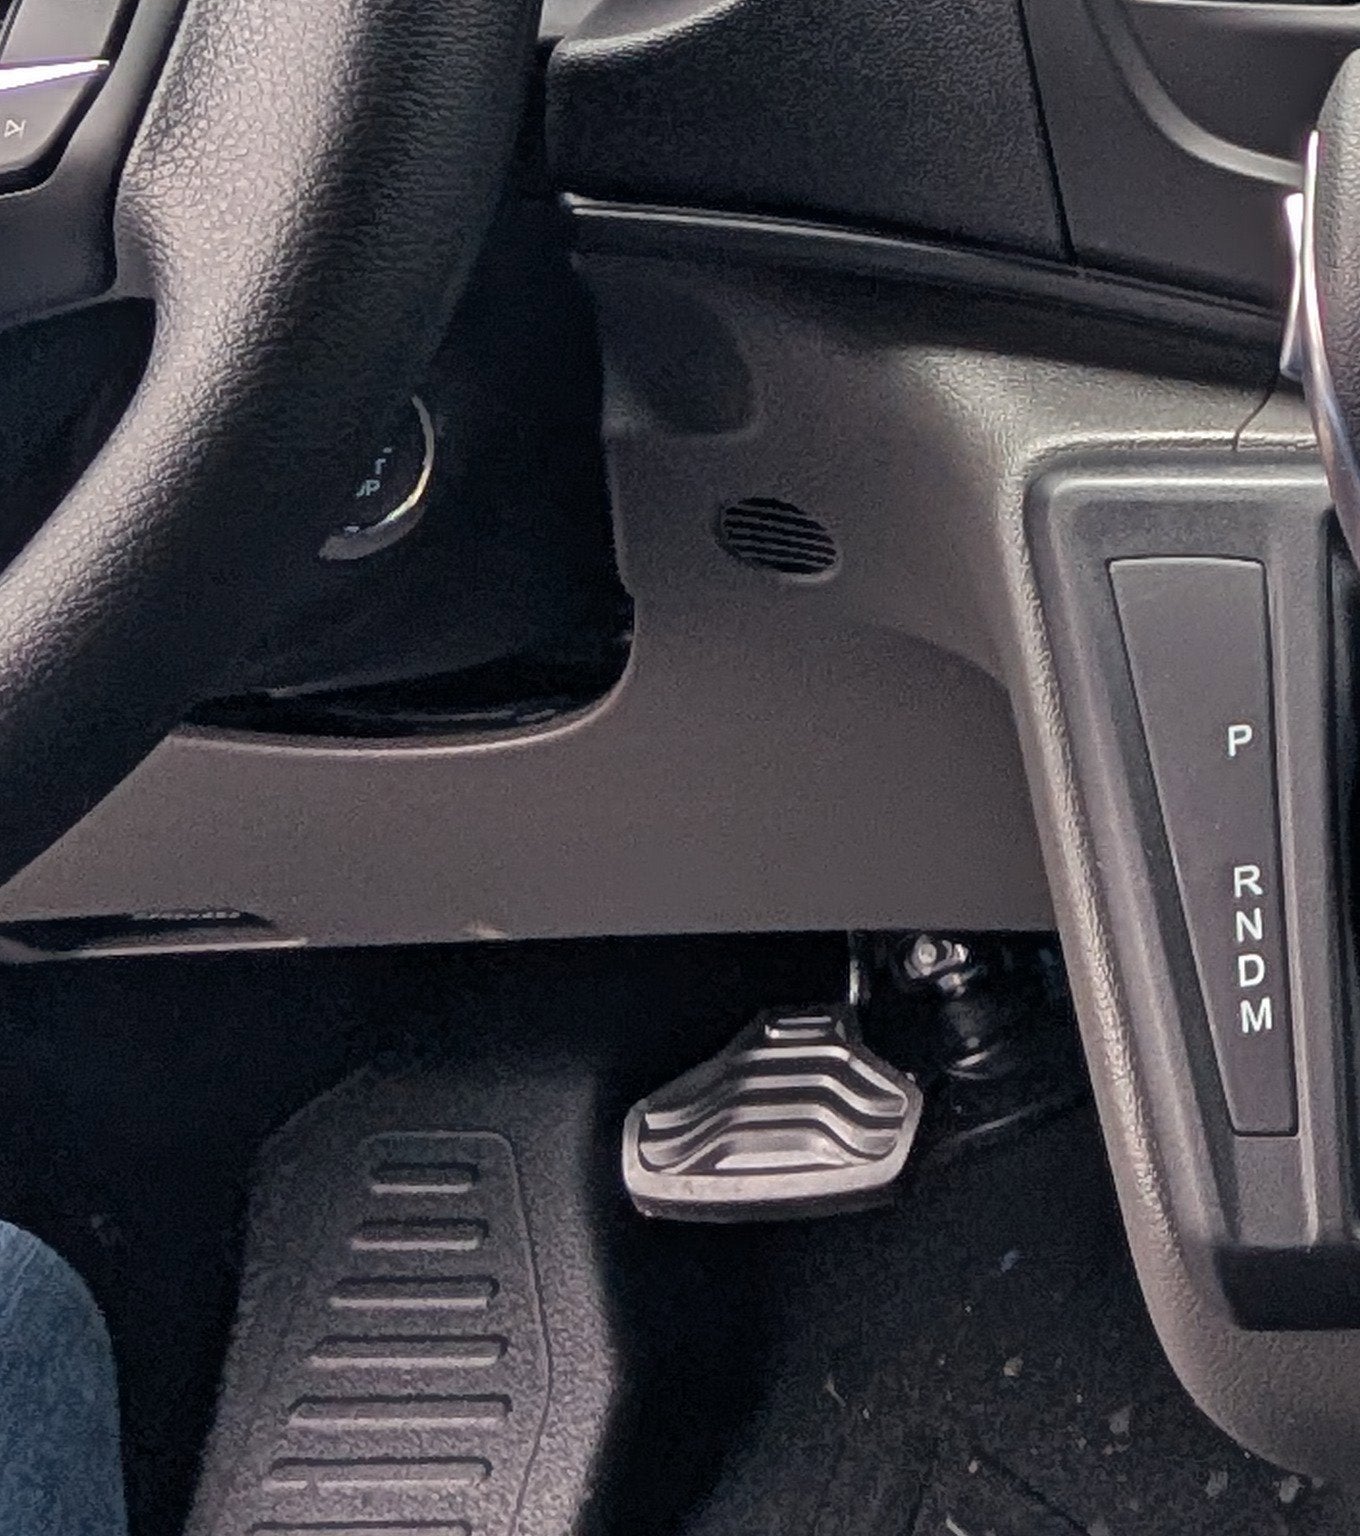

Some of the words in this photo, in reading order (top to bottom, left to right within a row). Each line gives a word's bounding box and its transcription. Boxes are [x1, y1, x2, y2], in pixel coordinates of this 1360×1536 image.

[1228, 724, 1252, 757] P
[1233, 864, 1262, 897] R
[1236, 908, 1262, 941] N
[1237, 954, 1264, 986] D
[1240, 998, 1272, 1033] M
